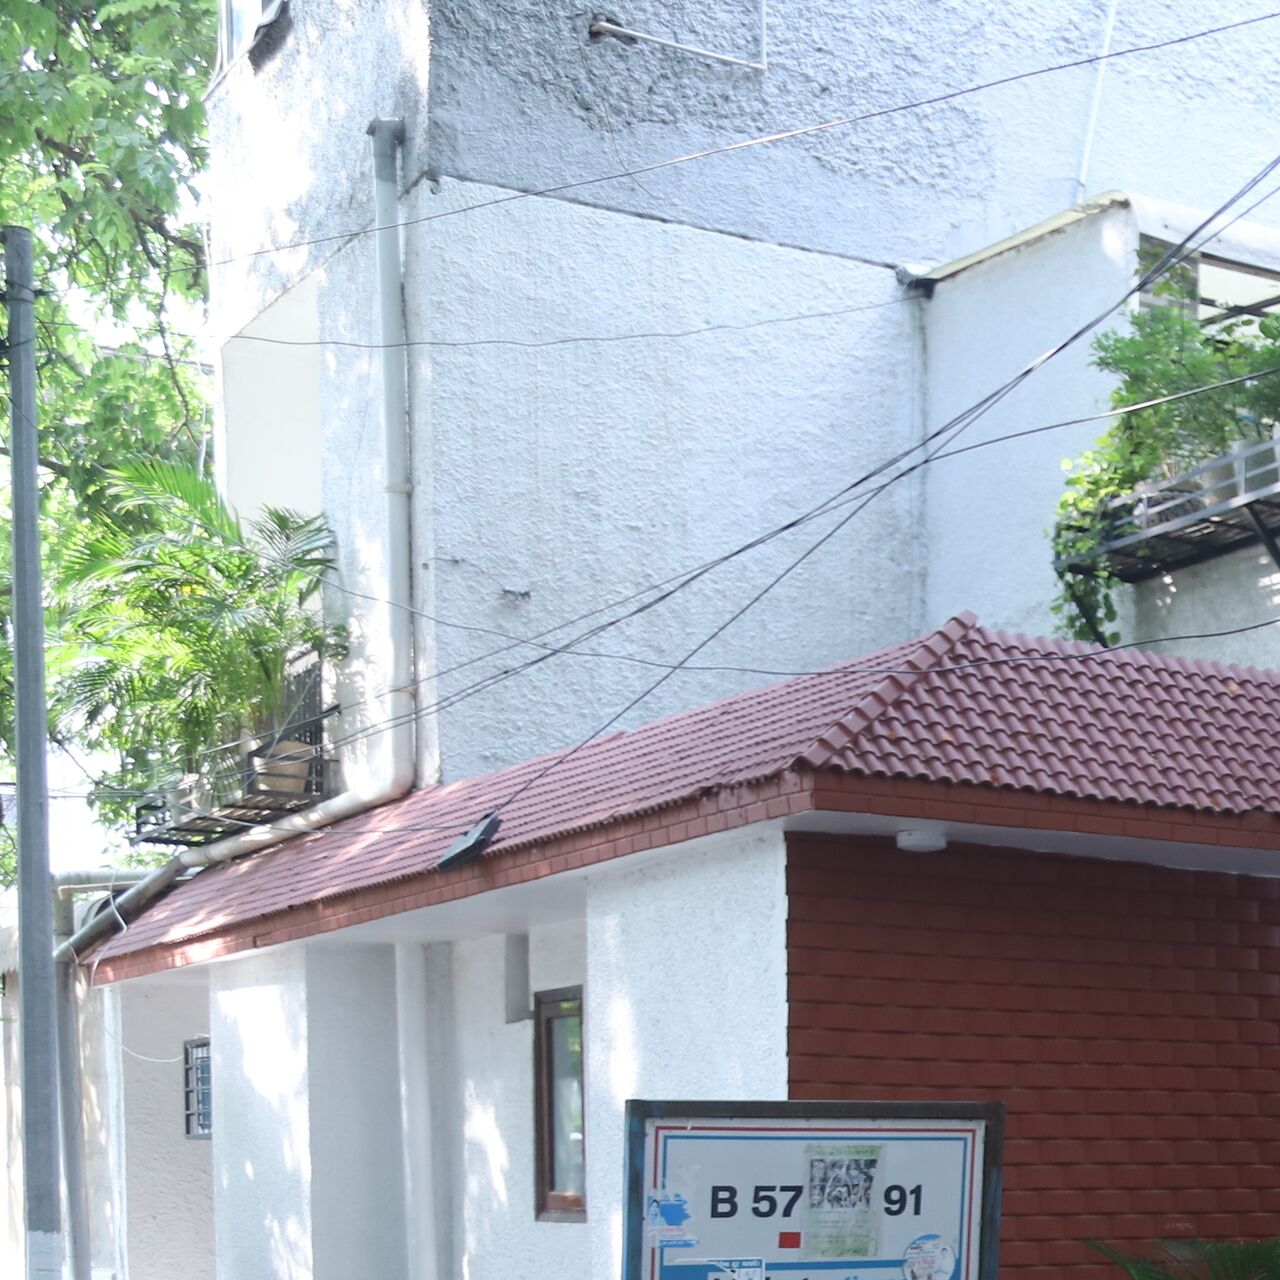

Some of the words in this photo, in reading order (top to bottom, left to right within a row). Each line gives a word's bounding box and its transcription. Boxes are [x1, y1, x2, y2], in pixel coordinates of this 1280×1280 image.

[711, 1185, 738, 1218] B
[752, 1185, 804, 1218] 57
[884, 1184, 922, 1216] 91
